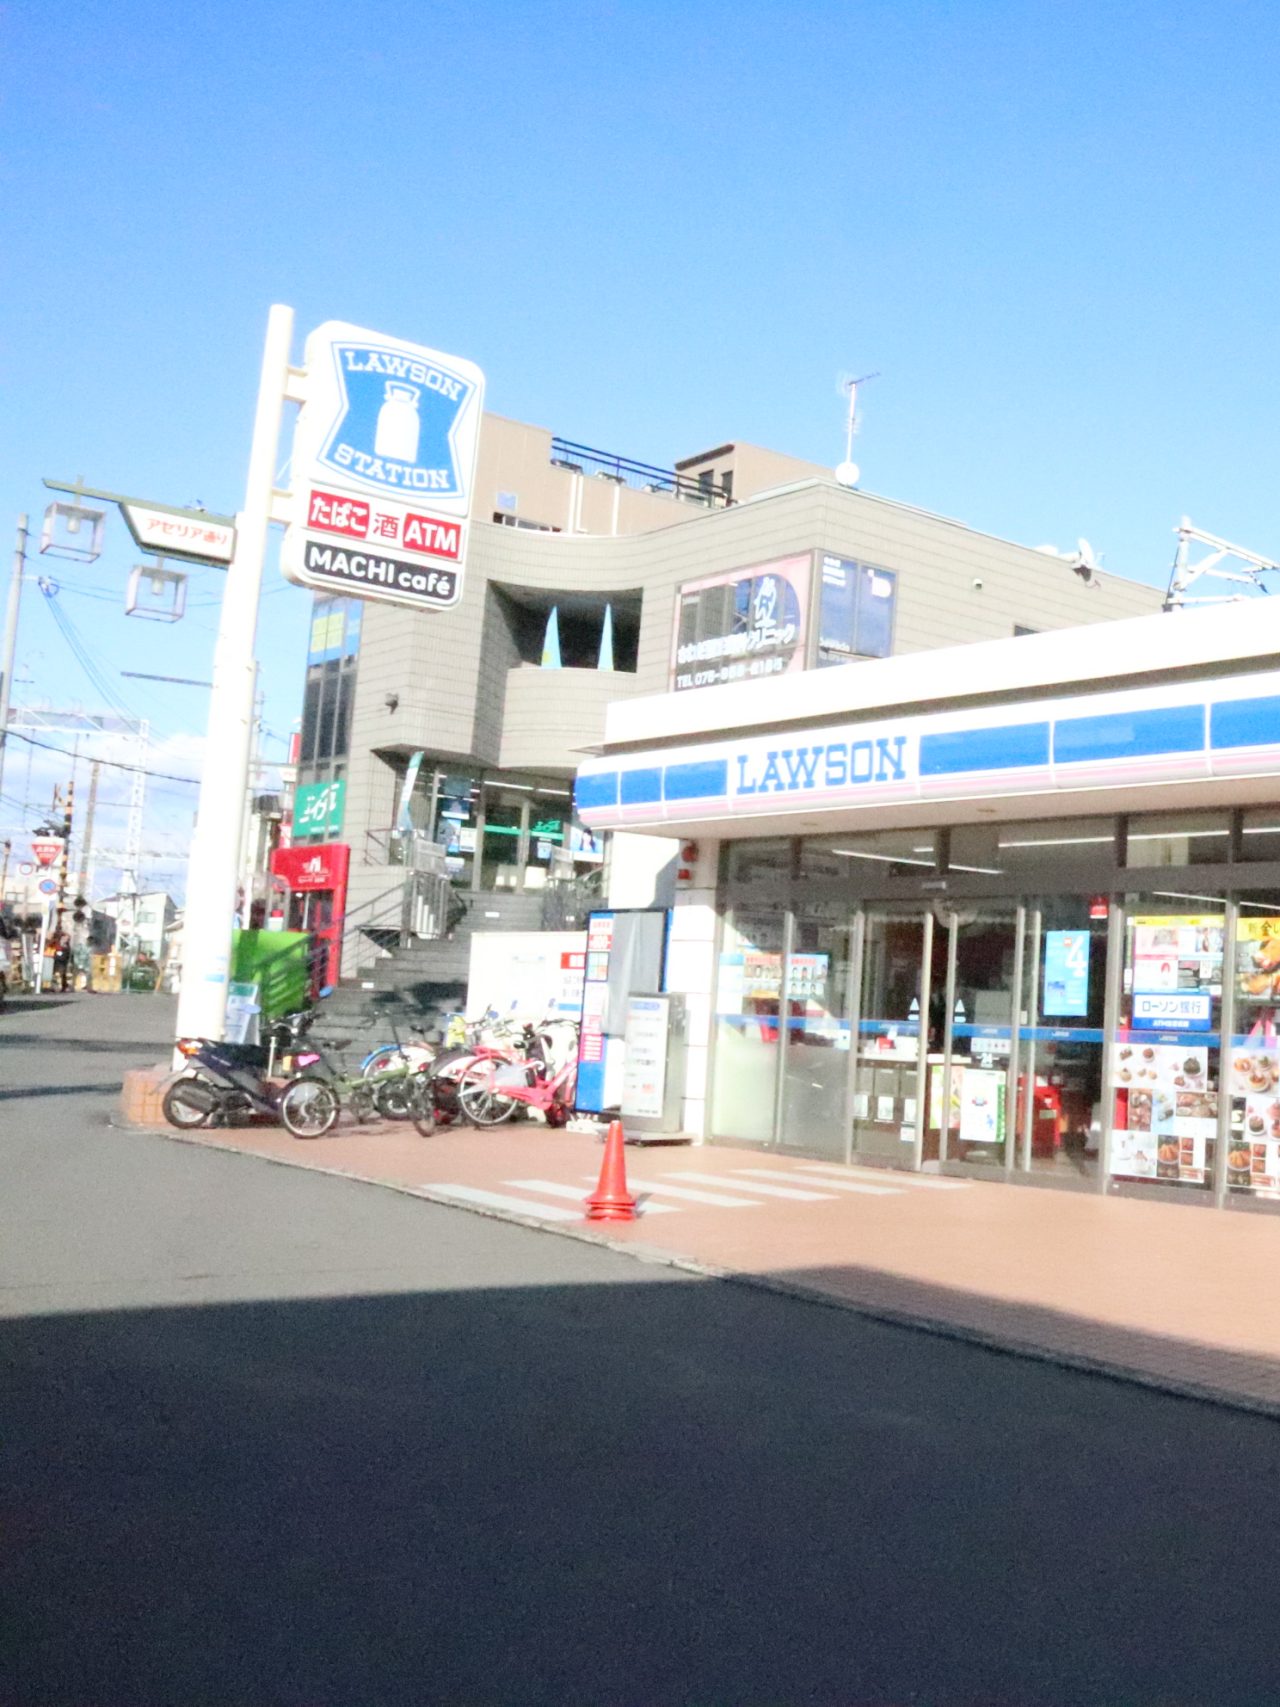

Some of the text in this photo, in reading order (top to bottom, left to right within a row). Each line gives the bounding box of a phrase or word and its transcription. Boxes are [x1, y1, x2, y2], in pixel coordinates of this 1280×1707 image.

[344, 351, 465, 402] LAWSON
[334, 443, 450, 489] STATION
[311, 496, 457, 553] たばこ 酒 ATM
[308, 546, 451, 596] MACHI café
[736, 735, 907, 795] LAWSON
